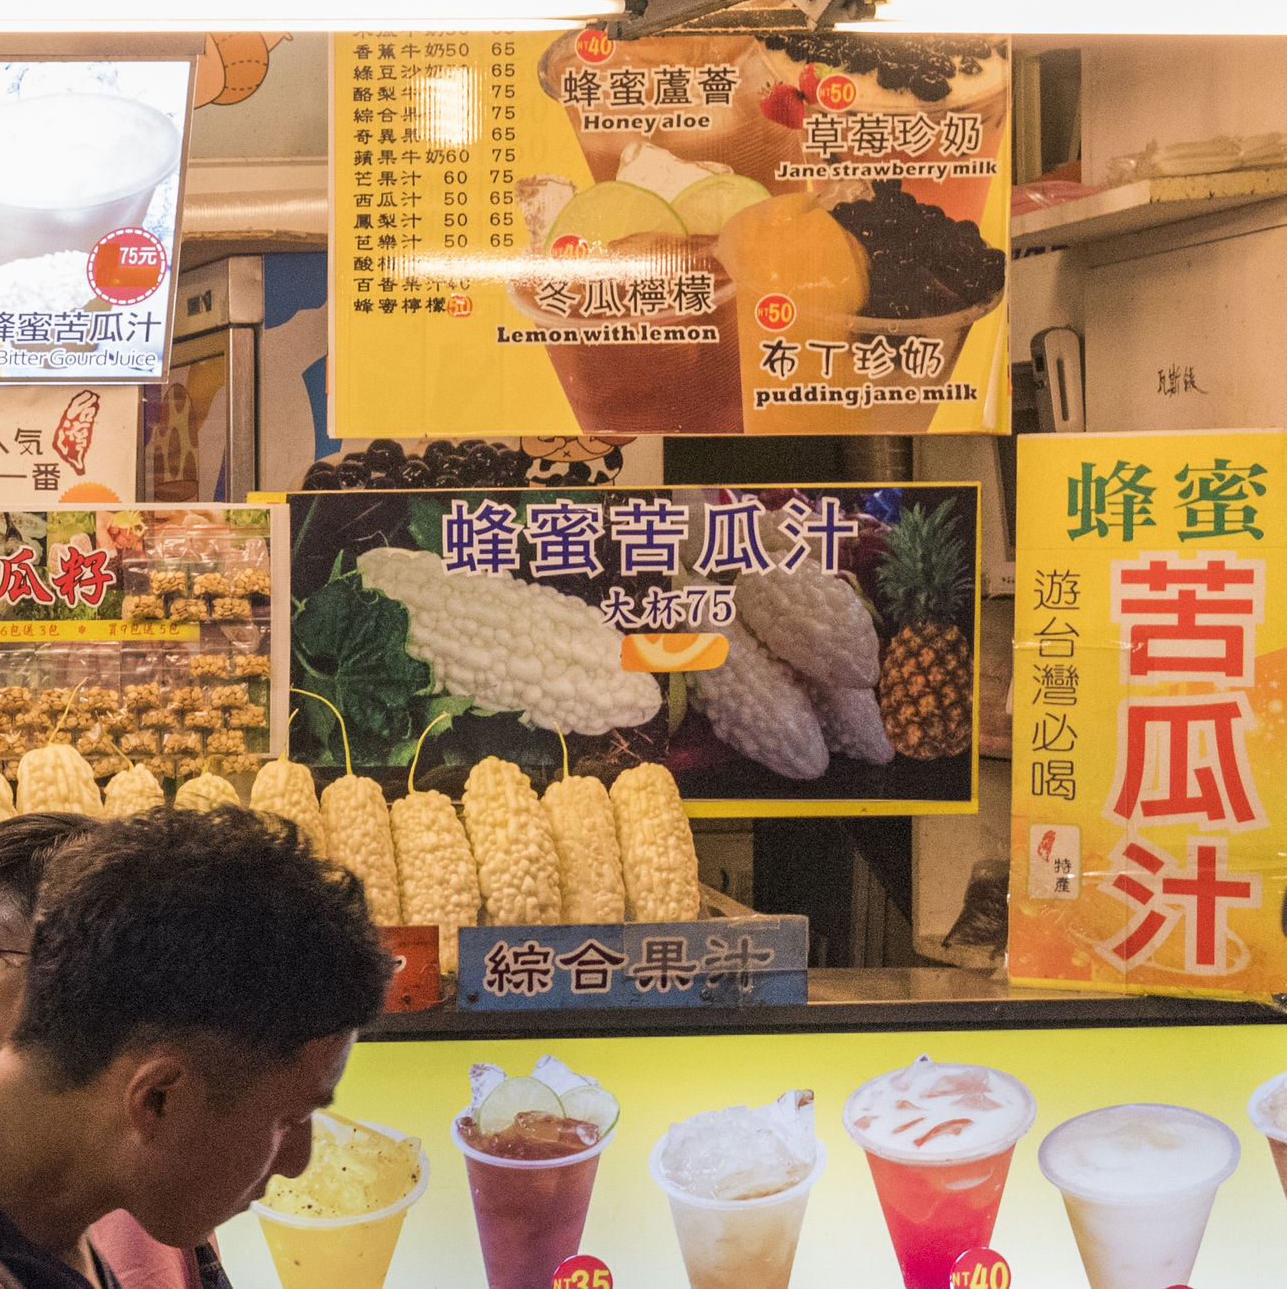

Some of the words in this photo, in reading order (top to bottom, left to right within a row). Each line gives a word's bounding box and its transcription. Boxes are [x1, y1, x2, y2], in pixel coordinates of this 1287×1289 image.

[446, 42, 469, 57] 50
[491, 42, 515, 56] 65
[561, 67, 738, 109] 蜂蜜蘆薈
[583, 113, 655, 133] Honey
[660, 113, 710, 130] aloe
[804, 114, 982, 158] 草莓珍奶
[446, 149, 470, 163] 60
[491, 148, 515, 162] 75
[354, 170, 421, 186] 芒果汁
[444, 170, 467, 184] 60
[490, 170, 514, 183] 75
[776, 162, 825, 180] Jane
[829, 162, 949, 183] strawberry
[952, 160, 998, 177] milk
[354, 191, 421, 208] 西瓜汁
[444, 192, 467, 205] 50
[490, 191, 514, 204] 65
[444, 234, 467, 248] 50
[490, 234, 514, 247] 65
[119, 246, 157, 265] 75元
[538, 275, 714, 316] 冬瓜檸檬
[496, 326, 580, 344] Lemon
[584, 326, 638, 343] with
[639, 325, 718, 343] lemon
[50, 349, 108, 366] Gourd
[110, 349, 156, 367] Juice
[759, 338, 944, 378] 布丁珍奶
[757, 386, 860, 410] pudding
[861, 386, 916, 410] jane
[922, 384, 978, 402] milk
[0, 464, 61, 492] 一番
[1067, 459, 1268, 543] 蜂蜜
[442, 499, 857, 577] 蜂蜜苦瓜汁
[602, 587, 736, 628] 大杯75
[1031, 568, 1082, 803] 遊台灣必喝
[1113, 560, 1255, 967] 苦瓜汁
[484, 938, 775, 996] 綜合果汁
